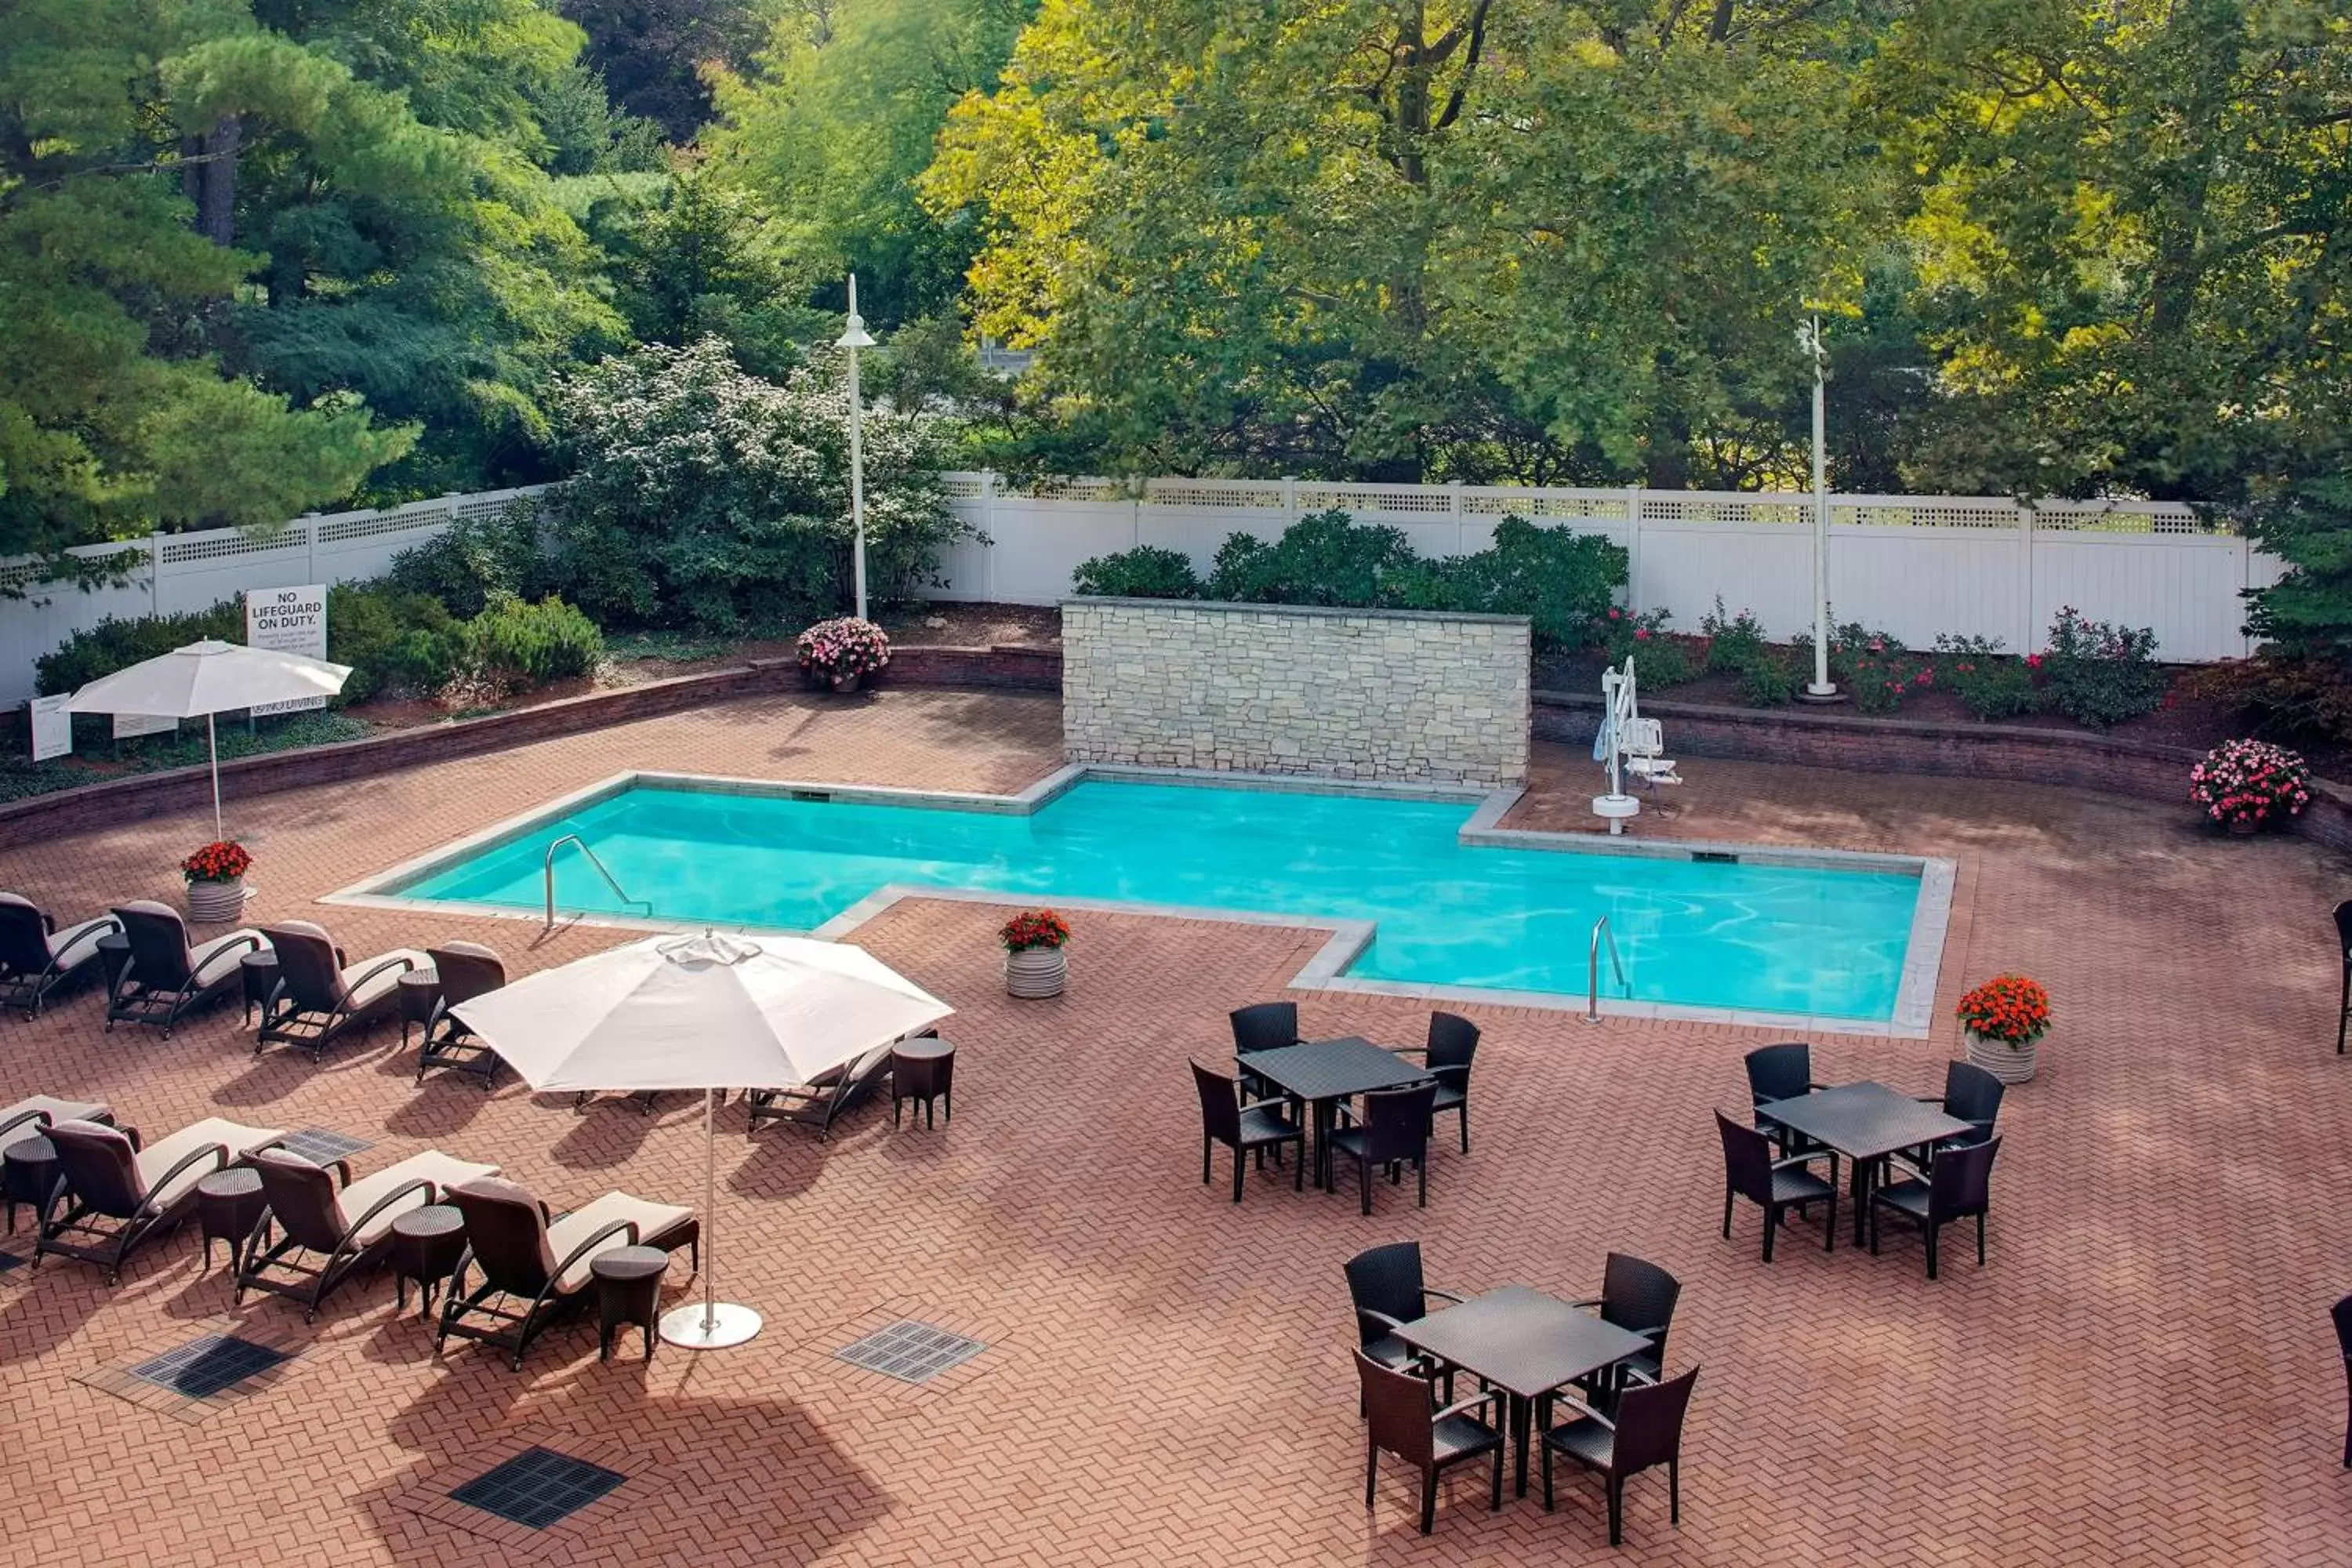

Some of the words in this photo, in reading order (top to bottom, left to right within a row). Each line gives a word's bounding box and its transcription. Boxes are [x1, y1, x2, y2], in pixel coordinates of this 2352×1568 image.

[278, 592, 297, 603] NO
[252, 602, 321, 619] LIFEGUARD
[258, 619, 277, 630] ON
[281, 615, 316, 628] DUTY.
